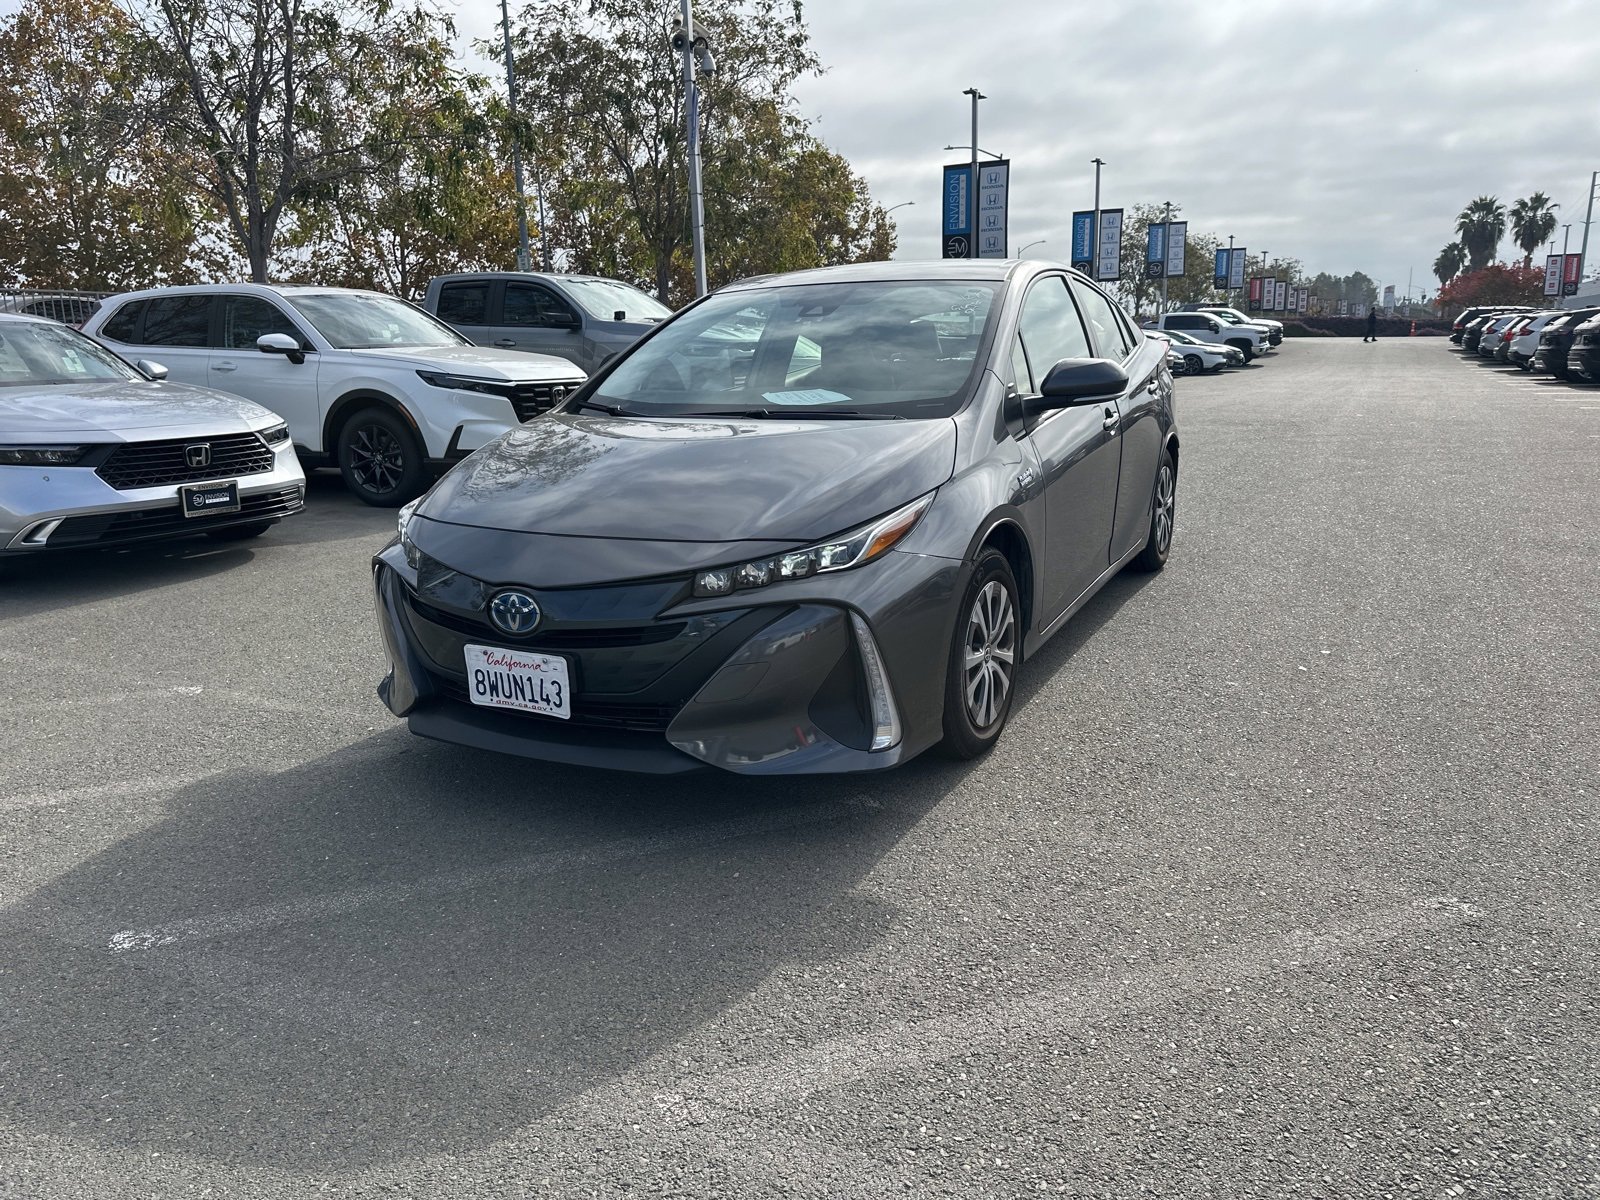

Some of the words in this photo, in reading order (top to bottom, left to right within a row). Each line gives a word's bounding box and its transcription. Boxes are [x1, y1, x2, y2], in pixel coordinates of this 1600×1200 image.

[950, 174, 960, 230] ENVISION
[1077, 218, 1085, 258] ENVISION
[486, 652, 548, 672] California
[474, 668, 563, 708] 8WUN143
[496, 699, 548, 711] dmv.ca.gov
